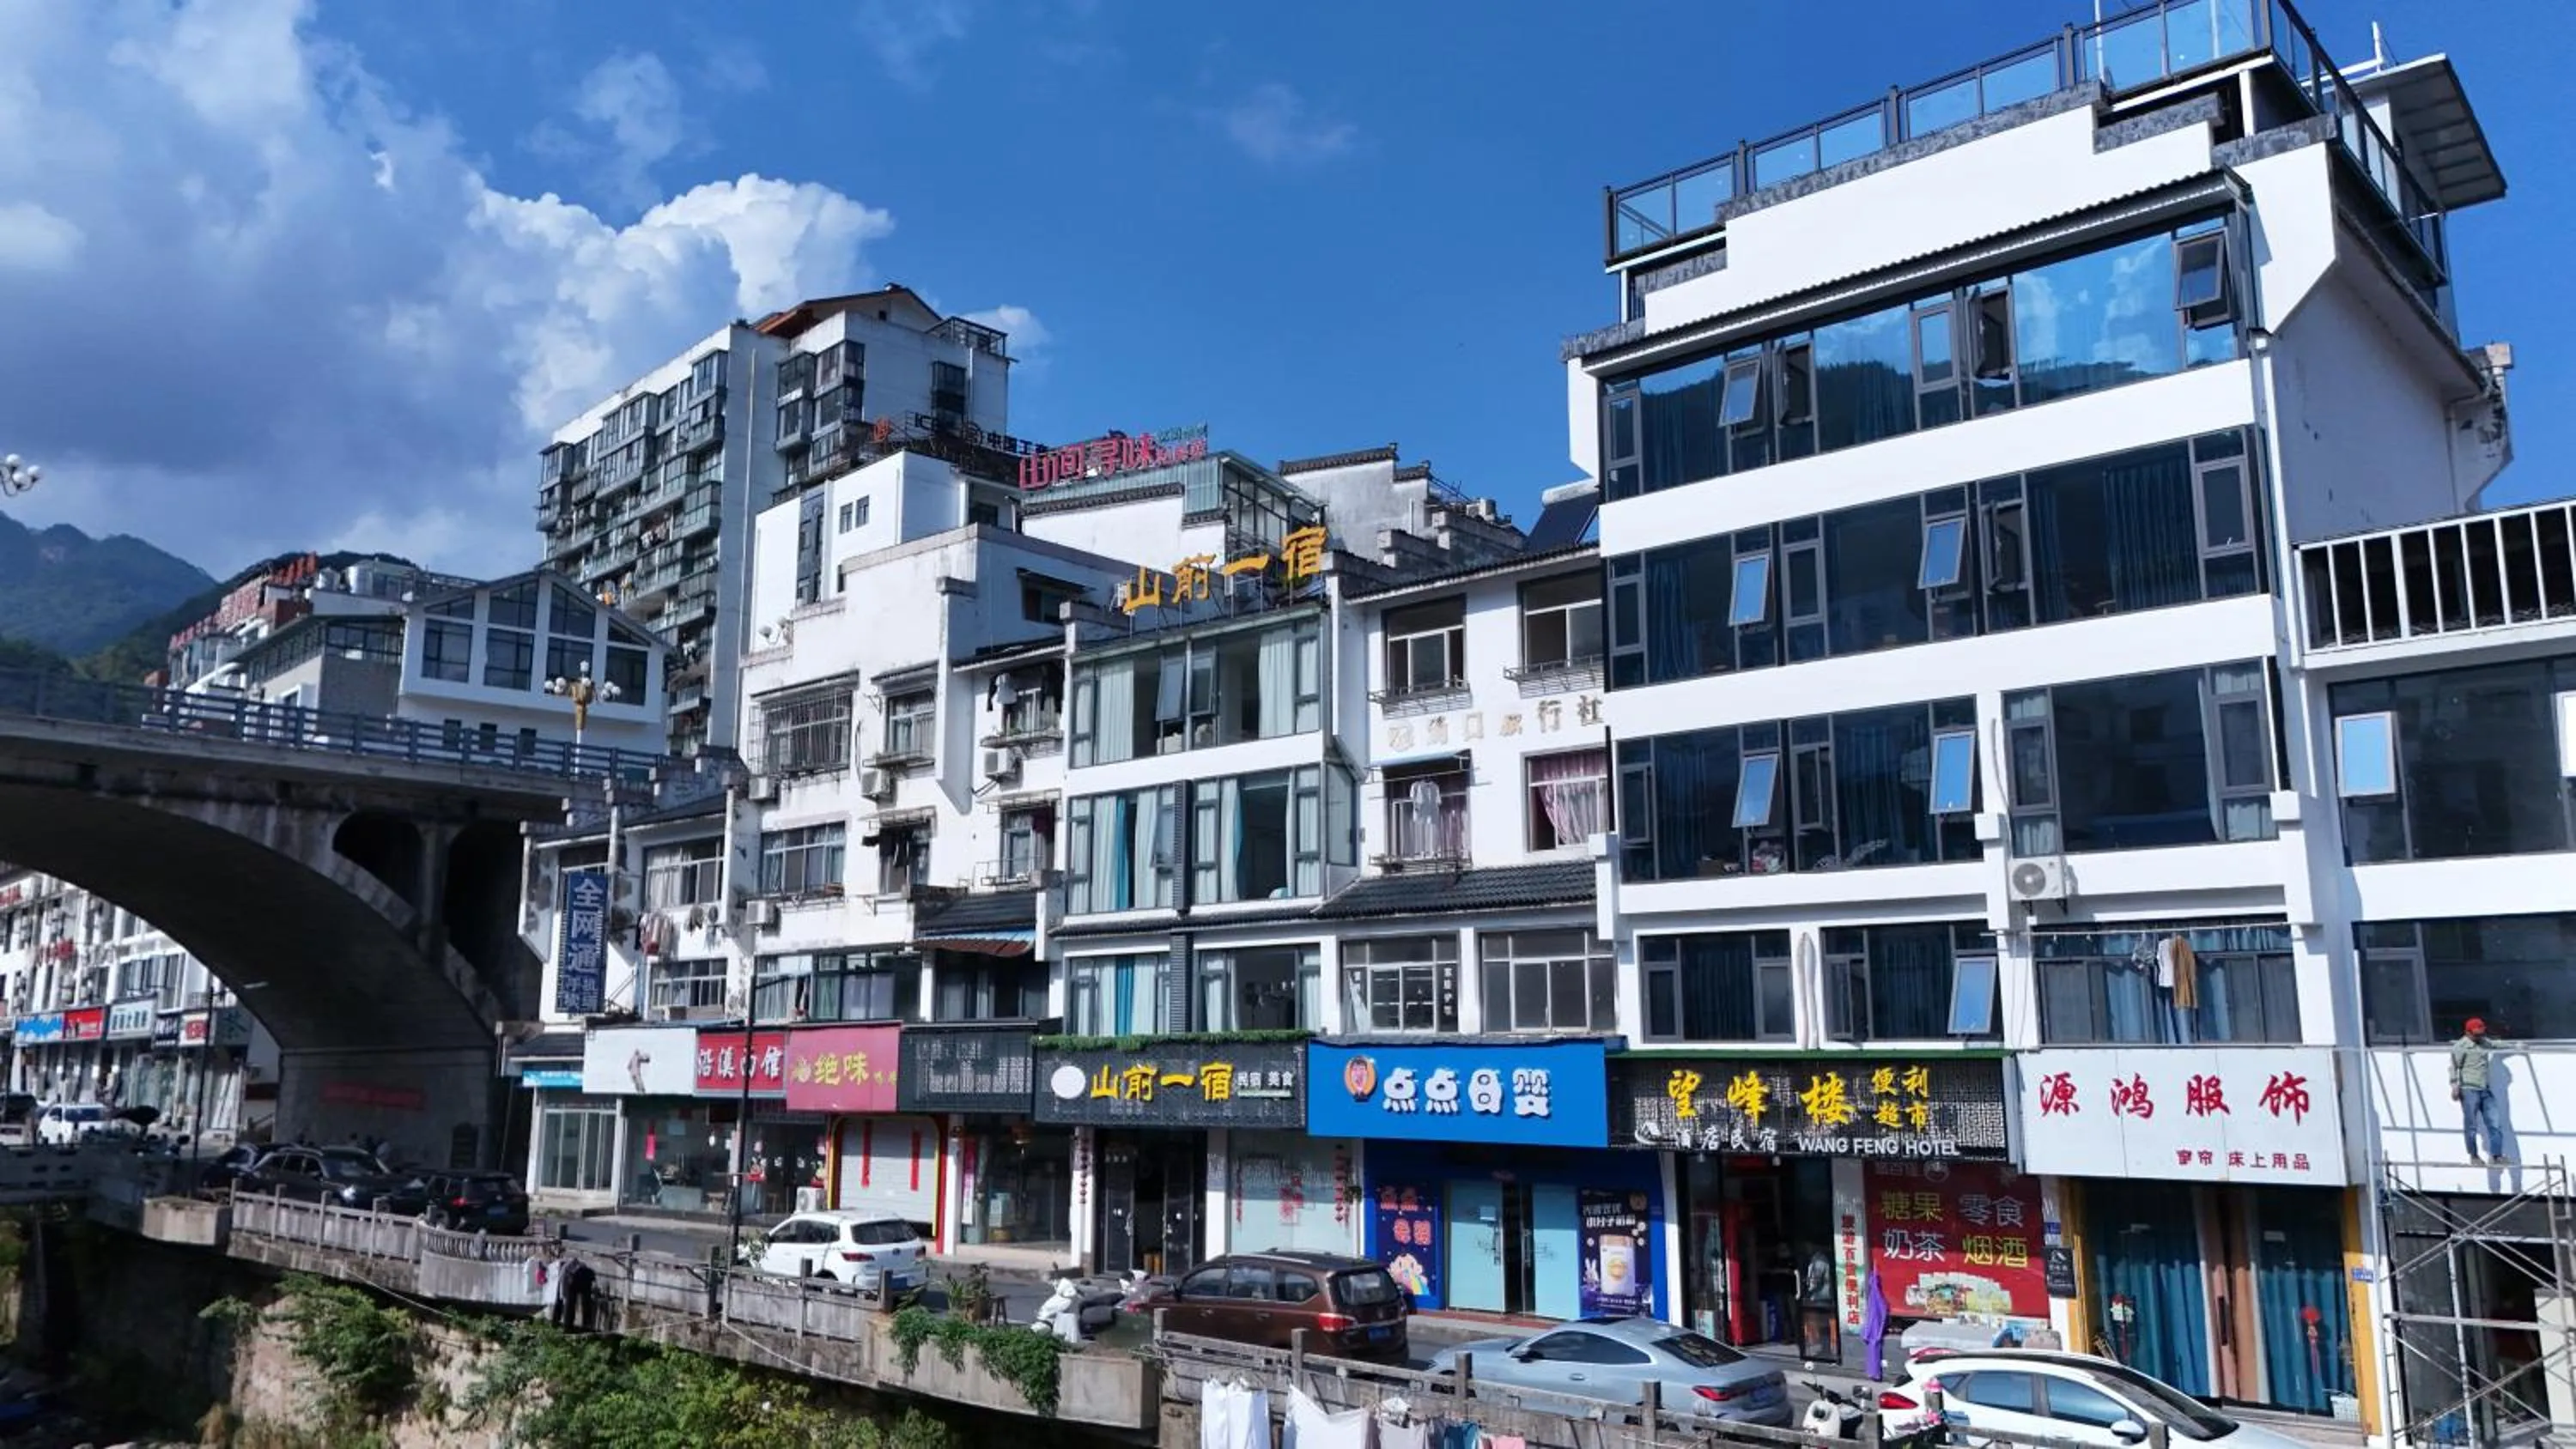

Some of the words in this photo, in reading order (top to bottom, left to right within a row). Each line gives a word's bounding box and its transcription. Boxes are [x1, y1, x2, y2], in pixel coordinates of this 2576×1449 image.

[1019, 433, 1154, 490] 山间寻味
[1122, 525, 1327, 613] 山前一宿
[569, 877, 604, 974] 全网通
[813, 1051, 870, 1086] 绝味
[1090, 1060, 1234, 1101] 山前一宿
[1267, 1070, 1294, 1087] 美食
[1870, 1065, 1931, 1098] 便利
[1667, 1069, 1857, 1127] 望峰楼
[1872, 1100, 1931, 1133] 超市
[2038, 1070, 2312, 1127] 源鸿服饰
[1674, 1126, 1778, 1151] 酒店民宿
[1799, 1135, 1849, 1154] WANG
[1853, 1137, 1899, 1155] FENG
[1905, 1138, 1960, 1156] HOTEL
[2227, 1151, 2312, 1172] 床上用品
[1880, 1191, 1945, 1222] 糖果
[1959, 1192, 2025, 1228] 零食
[1882, 1228, 1946, 1262] 奶茶
[1962, 1235, 2029, 1269] 烟酒
